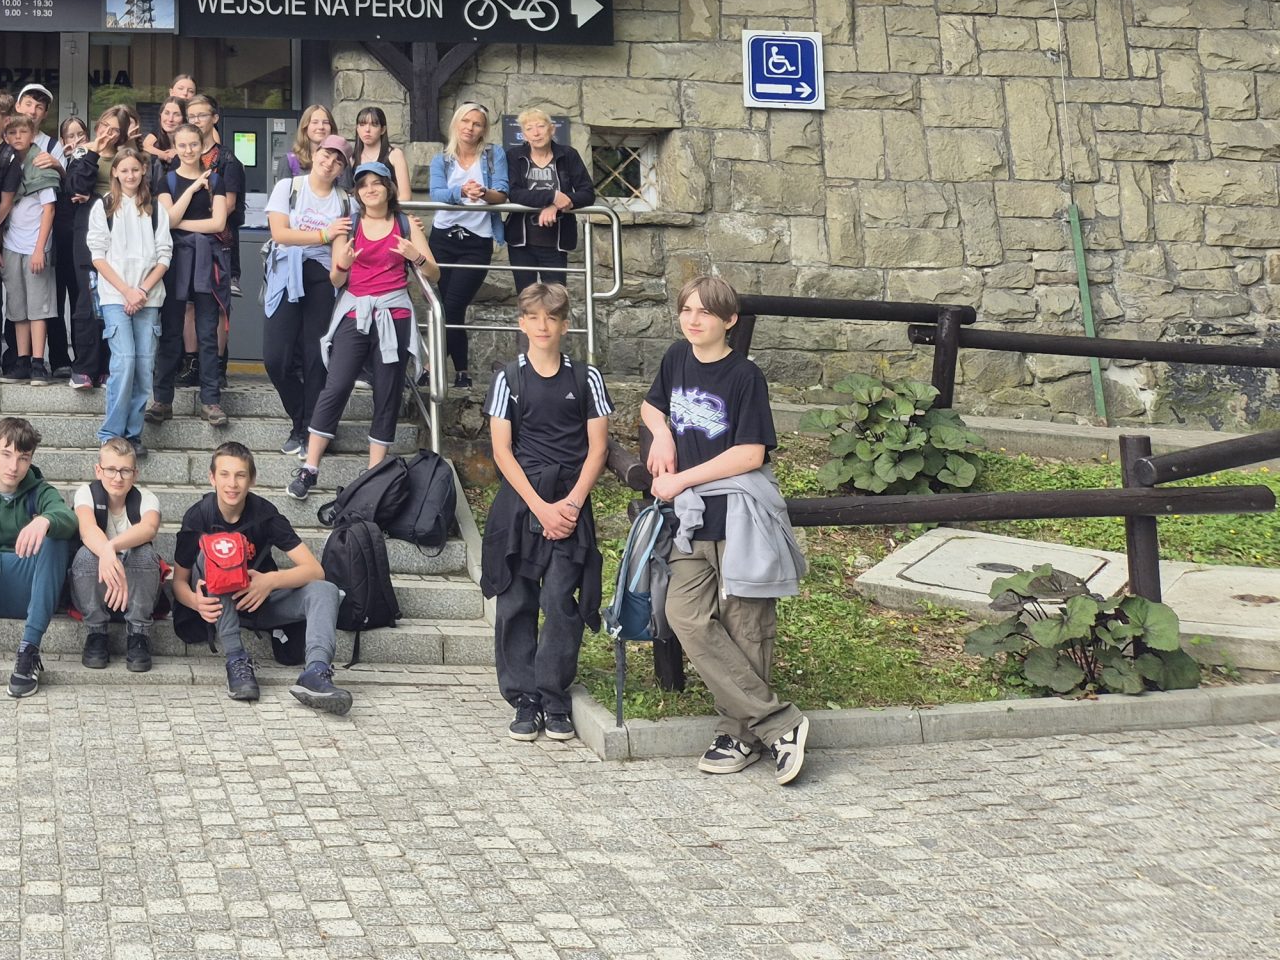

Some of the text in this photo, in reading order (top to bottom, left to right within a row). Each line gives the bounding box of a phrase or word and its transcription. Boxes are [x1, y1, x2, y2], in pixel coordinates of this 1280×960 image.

[1, 0, 22, 7] 10.00
[4, 9, 21, 17] 9.00
[32, 9, 53, 17] 19.30
